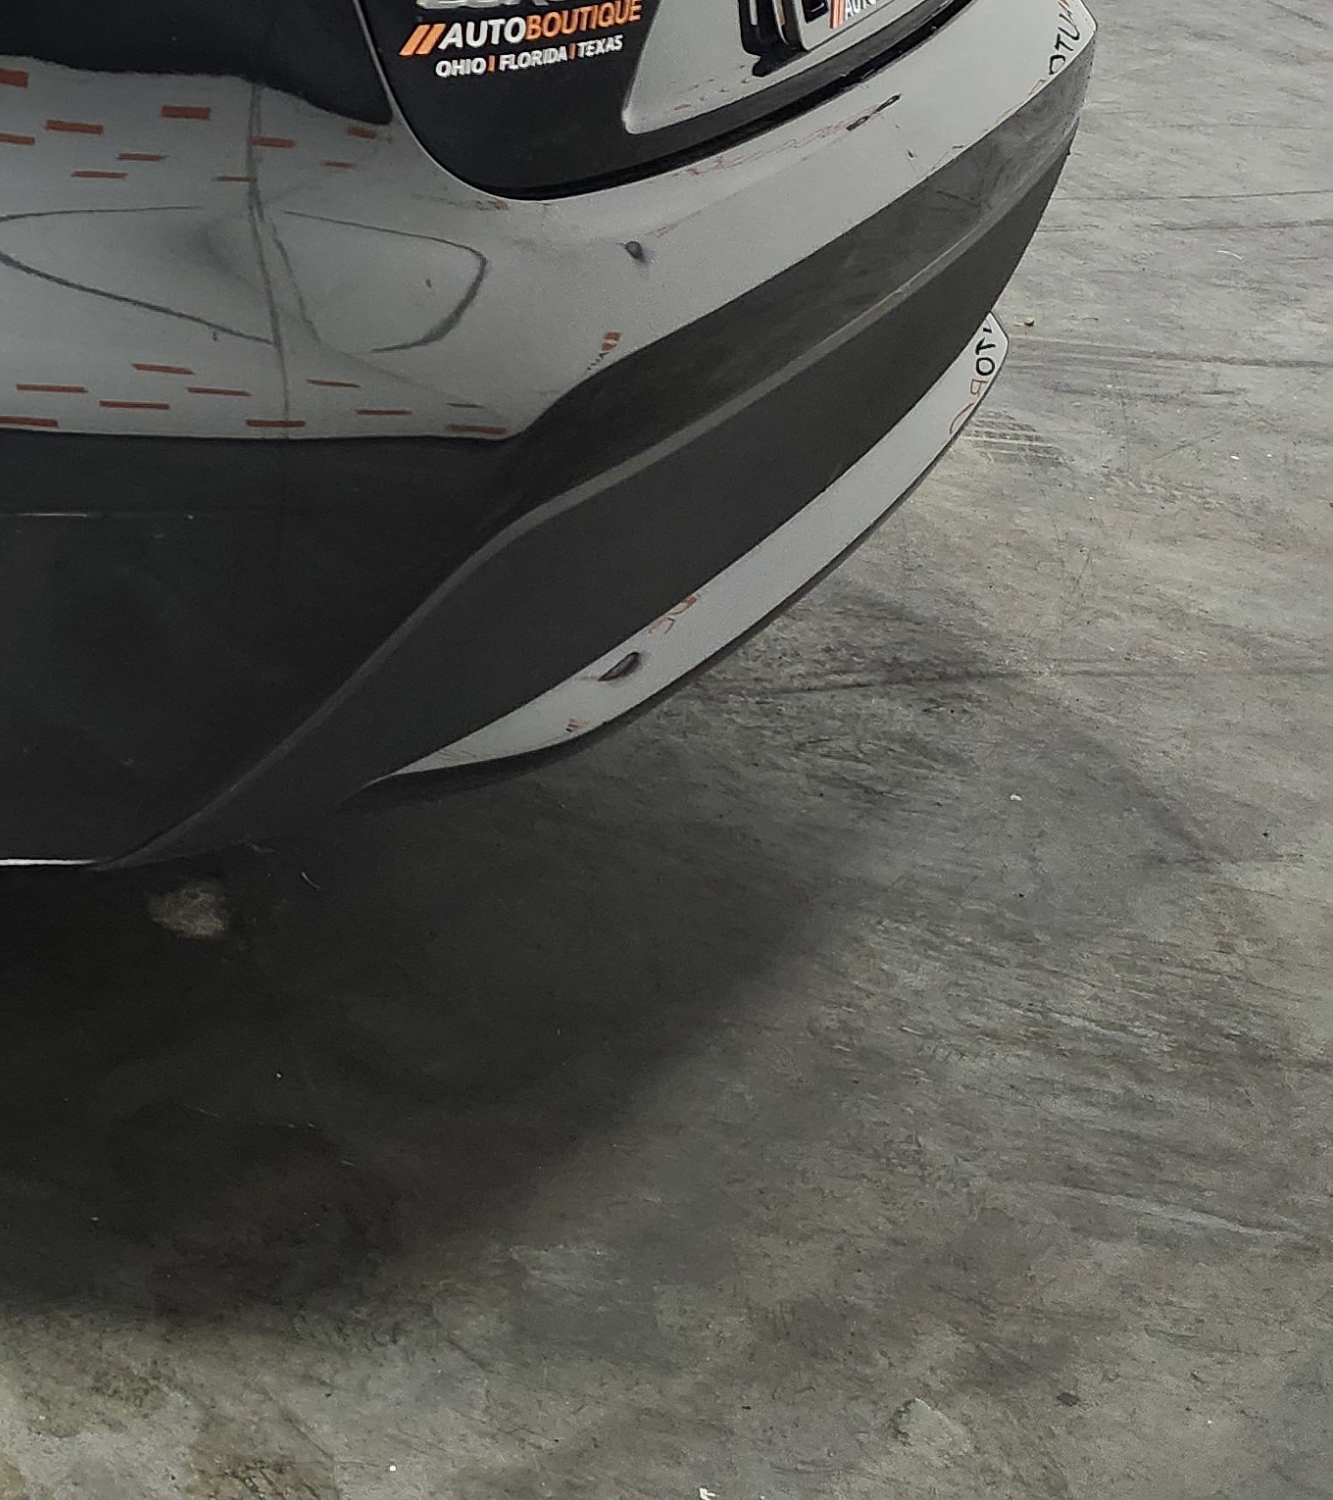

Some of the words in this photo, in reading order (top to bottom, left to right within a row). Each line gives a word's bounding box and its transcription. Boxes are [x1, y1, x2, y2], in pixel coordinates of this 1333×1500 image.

[435, 58, 487, 78] OHIO
[498, 46, 568, 72] FLORIDA
[577, 34, 624, 59] TEXAS
